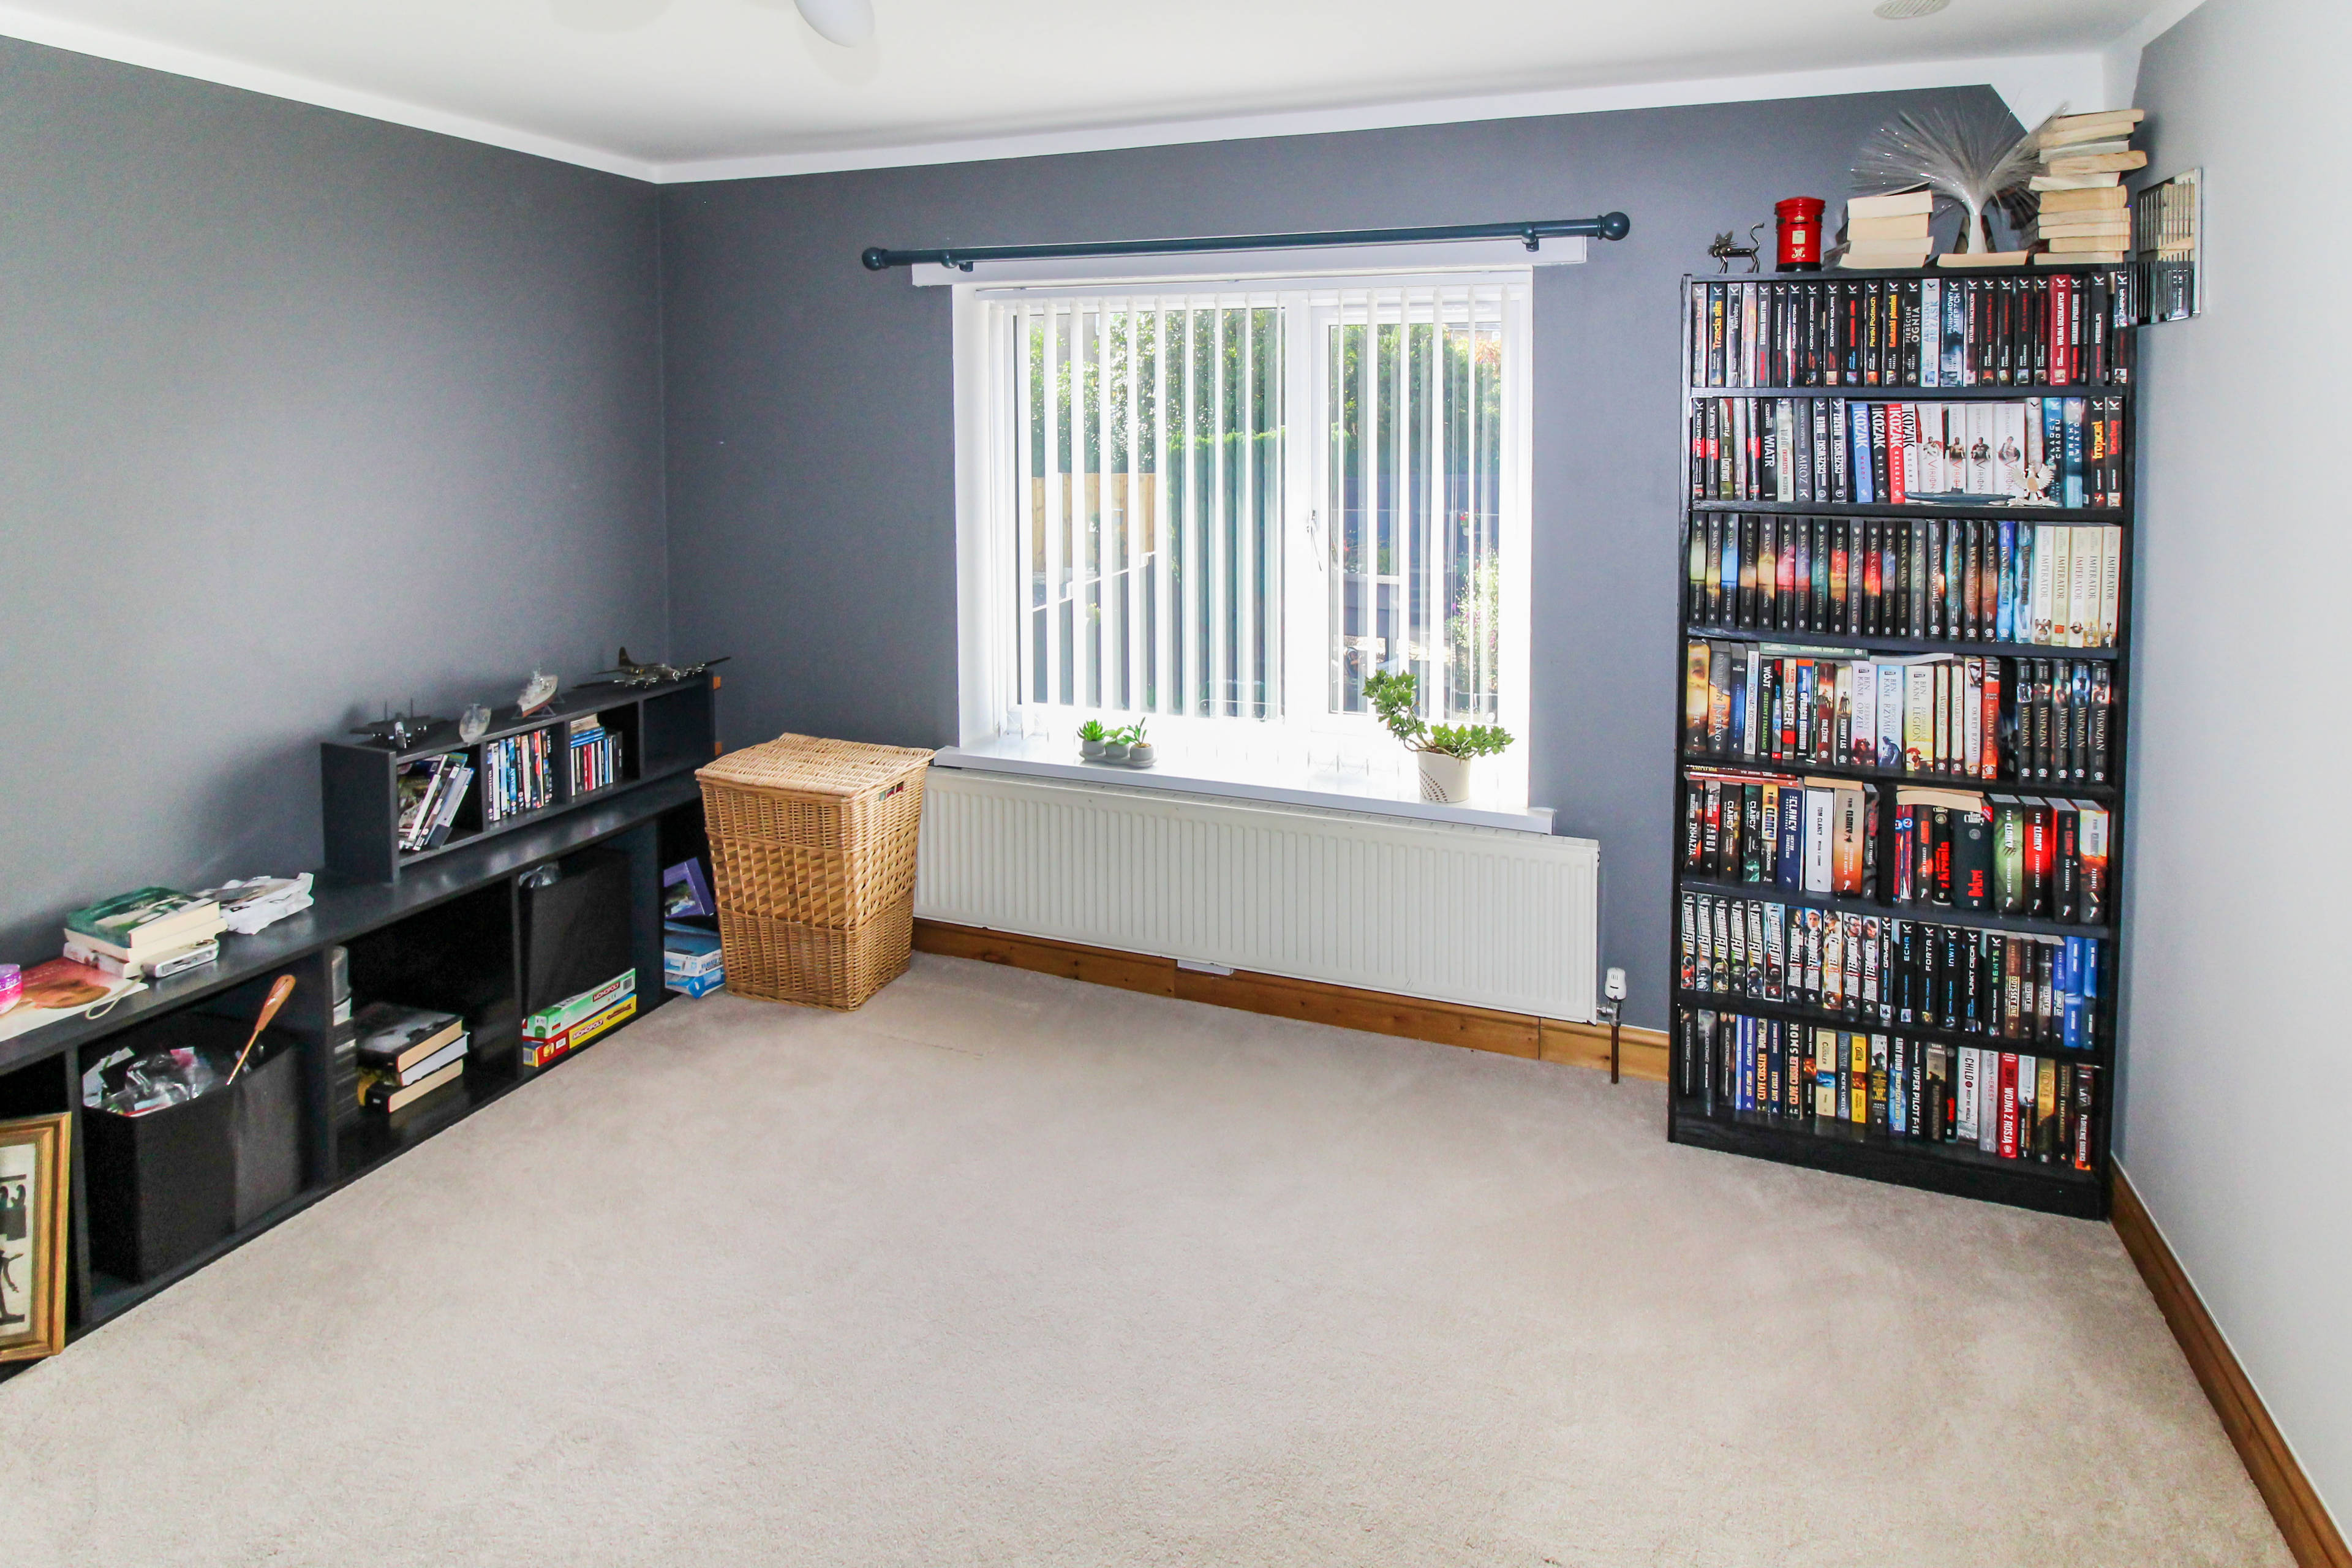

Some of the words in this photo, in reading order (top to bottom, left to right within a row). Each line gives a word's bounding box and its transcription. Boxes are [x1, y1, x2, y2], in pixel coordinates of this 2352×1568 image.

[1912, 307, 1920, 342] OGNIA
[1833, 413, 1842, 435] DESZCZ
[1854, 410, 1868, 448] KOZAK
[1872, 411, 1885, 449] KOZAK
[1890, 410, 1902, 449] KOZAK
[1903, 411, 1915, 448] KOZAK
[1765, 434, 1775, 467] WIATR
[1817, 440, 1826, 474] CISZEWSKI
[1834, 440, 1844, 473] CISZEWSKI
[1799, 455, 1809, 484] MRÓZ
[2040, 555, 2049, 598] IMPERATOR
[2057, 556, 2065, 599] IMPERATOR
[2074, 557, 2083, 599] IMPERATOR
[2088, 556, 2097, 599] IMPERATOR
[2106, 556, 2116, 600] IMPERATOR
[1763, 666, 1773, 688] WÓJT
[1714, 704, 1725, 741] INFERNO
[1784, 689, 1794, 725] SAPER
[2039, 707, 2048, 747] WESPAZJAN
[2077, 707, 2086, 747] WESPAZJAN
[2095, 710, 2106, 750] WESPAZJAN
[1789, 799, 1797, 831] CLANCY
[1688, 822, 1697, 855] INWAZJA
[594, 983, 619, 1000] MONOPOLY
[573, 1019, 603, 1039] MONOPOLY
[1790, 1024, 1799, 1054] SMOK
[1758, 1054, 1766, 1081] CUSSLER
[1790, 1057, 1798, 1084] CUSSLER
[1965, 1058, 1973, 1080] CHILD
[1790, 1086, 1798, 1104] CLIVE
[2004, 1087, 2013, 1112] WOJNA
[2003, 1121, 2012, 1143] ROSJĄ
